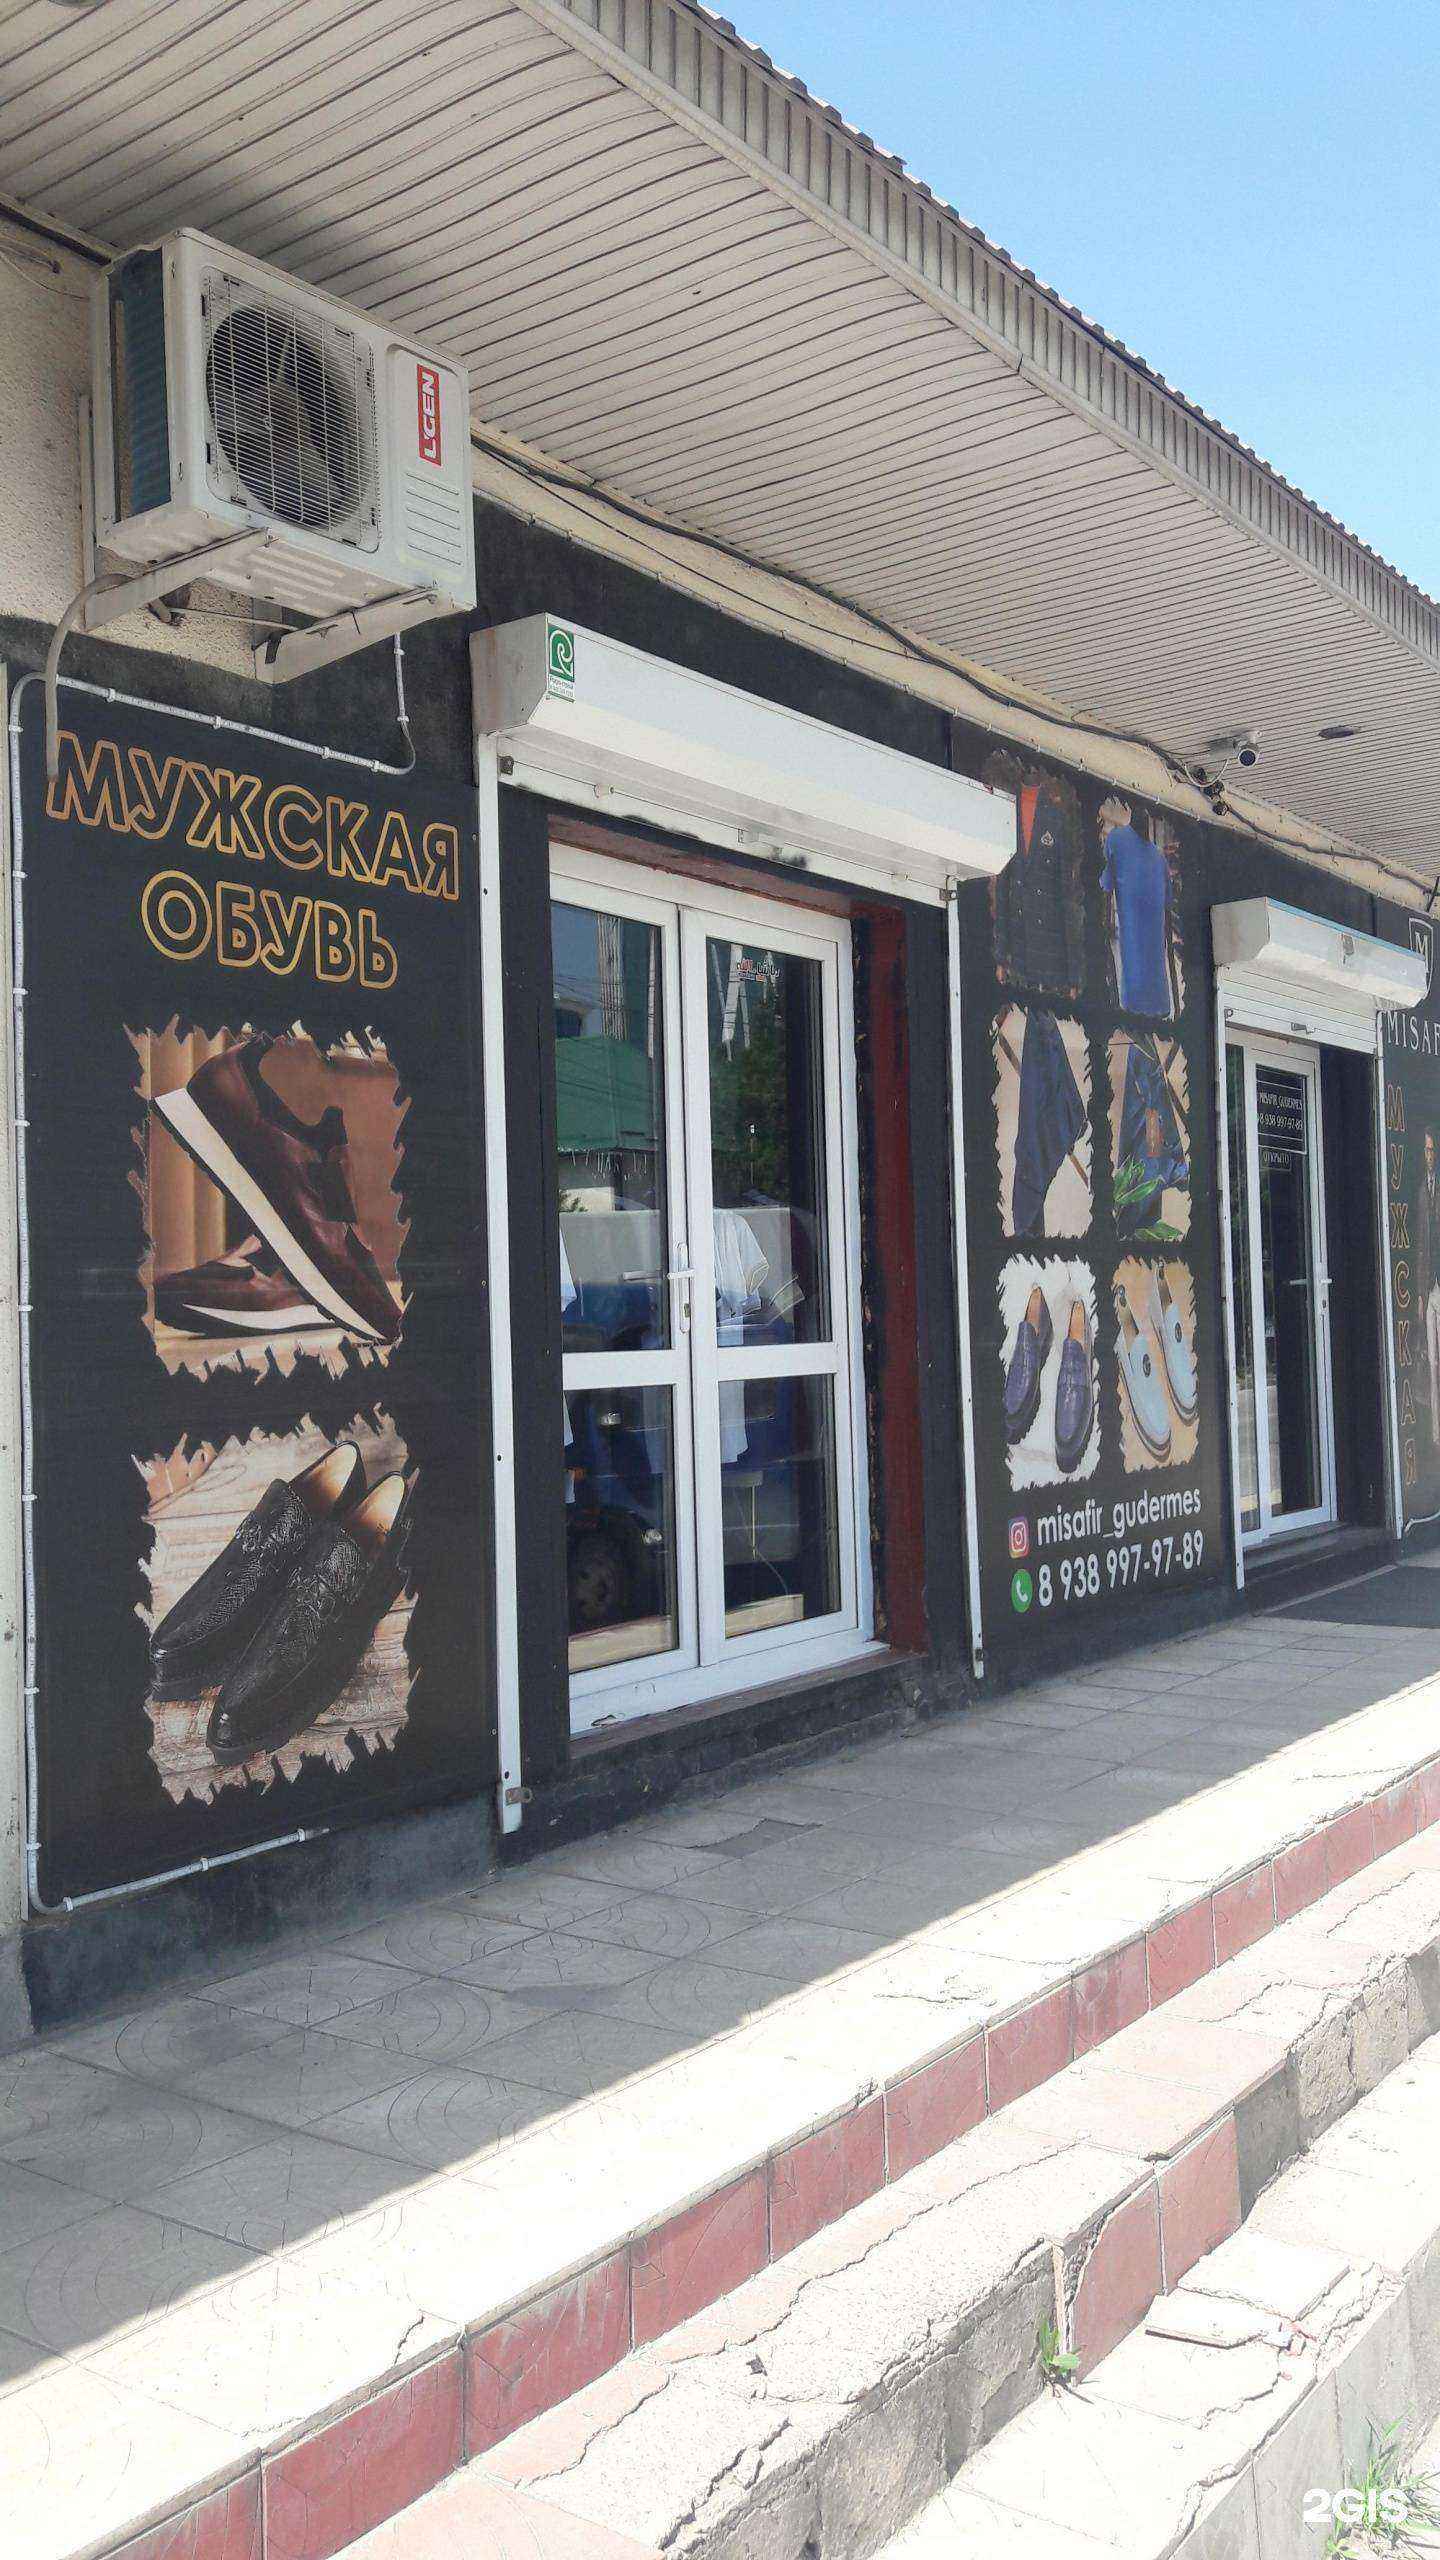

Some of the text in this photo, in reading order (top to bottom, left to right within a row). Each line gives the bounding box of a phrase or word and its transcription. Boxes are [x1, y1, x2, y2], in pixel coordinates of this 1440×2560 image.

[46, 731, 460, 901] МУЖСКАЯ
[141, 870, 398, 989] ОБУВЬ
[1387, 1084, 1417, 1486] МУЖСКАЯ
[1037, 1488, 1201, 1545] misafir_gudermes
[1038, 1529, 1204, 1607] 8 938 997-97-89
